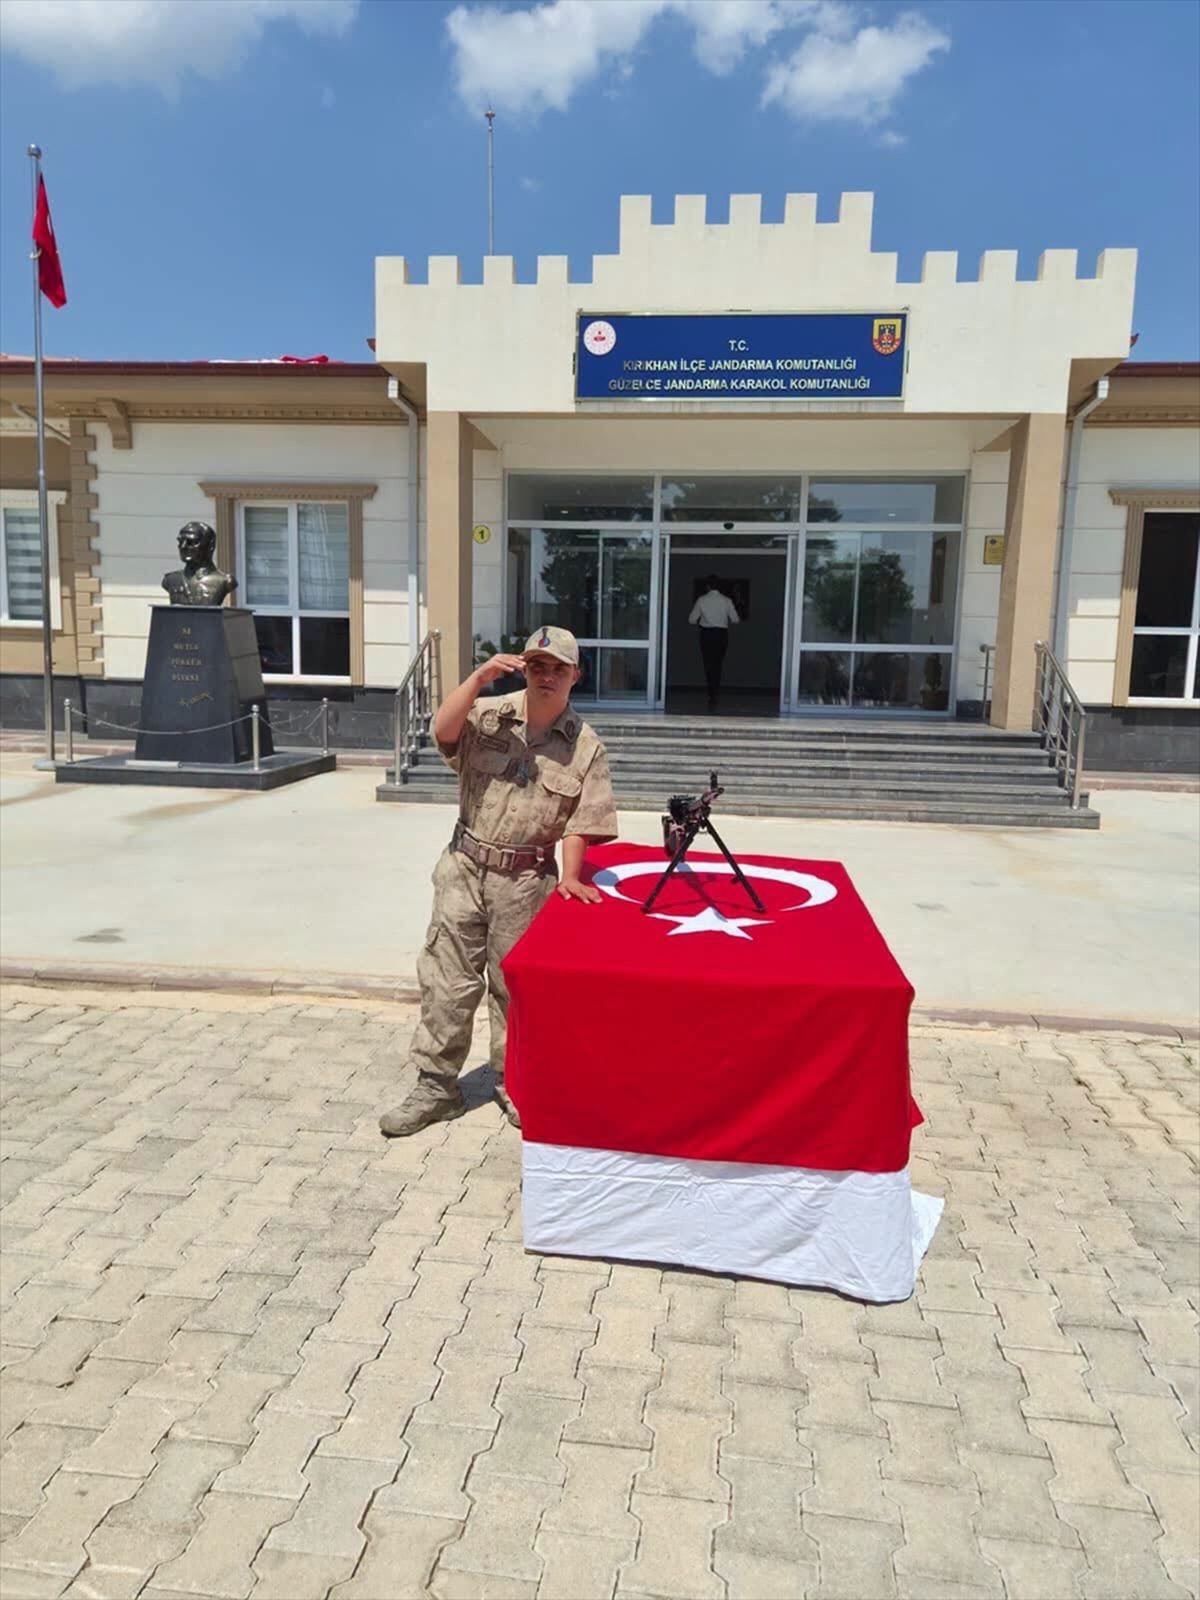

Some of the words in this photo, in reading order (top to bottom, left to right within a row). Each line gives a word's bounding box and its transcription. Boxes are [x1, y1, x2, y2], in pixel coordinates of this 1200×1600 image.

[729, 340, 749, 351] T.C.
[680, 358, 706, 373] İLÇE
[708, 360, 773, 370] JANDARMA
[776, 357, 857, 370] KOMUTANLIĞI
[664, 379, 728, 390] JANDARMA
[730, 378, 787, 389] KARAKOL
[790, 376, 870, 389] KOMUTANLIĞI
